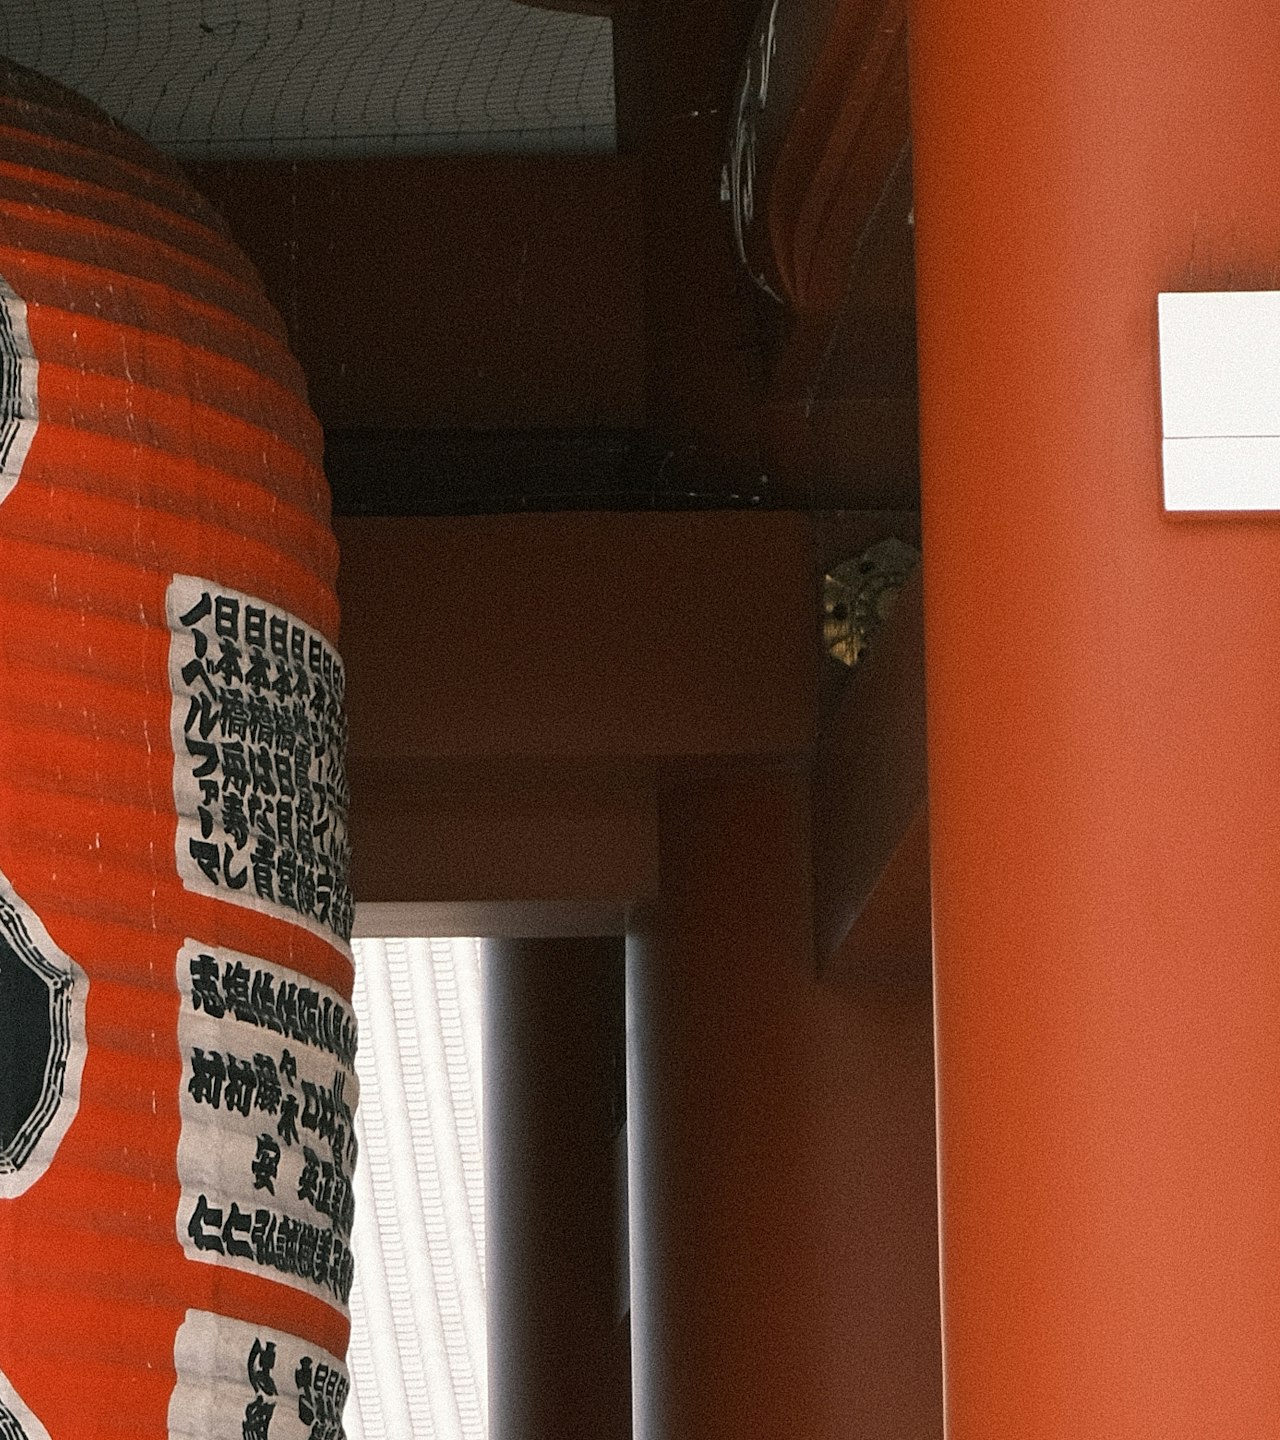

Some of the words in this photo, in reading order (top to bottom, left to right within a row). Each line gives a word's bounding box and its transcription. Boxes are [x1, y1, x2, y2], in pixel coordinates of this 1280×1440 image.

[179, 591, 221, 887] ノーベルファーマ
